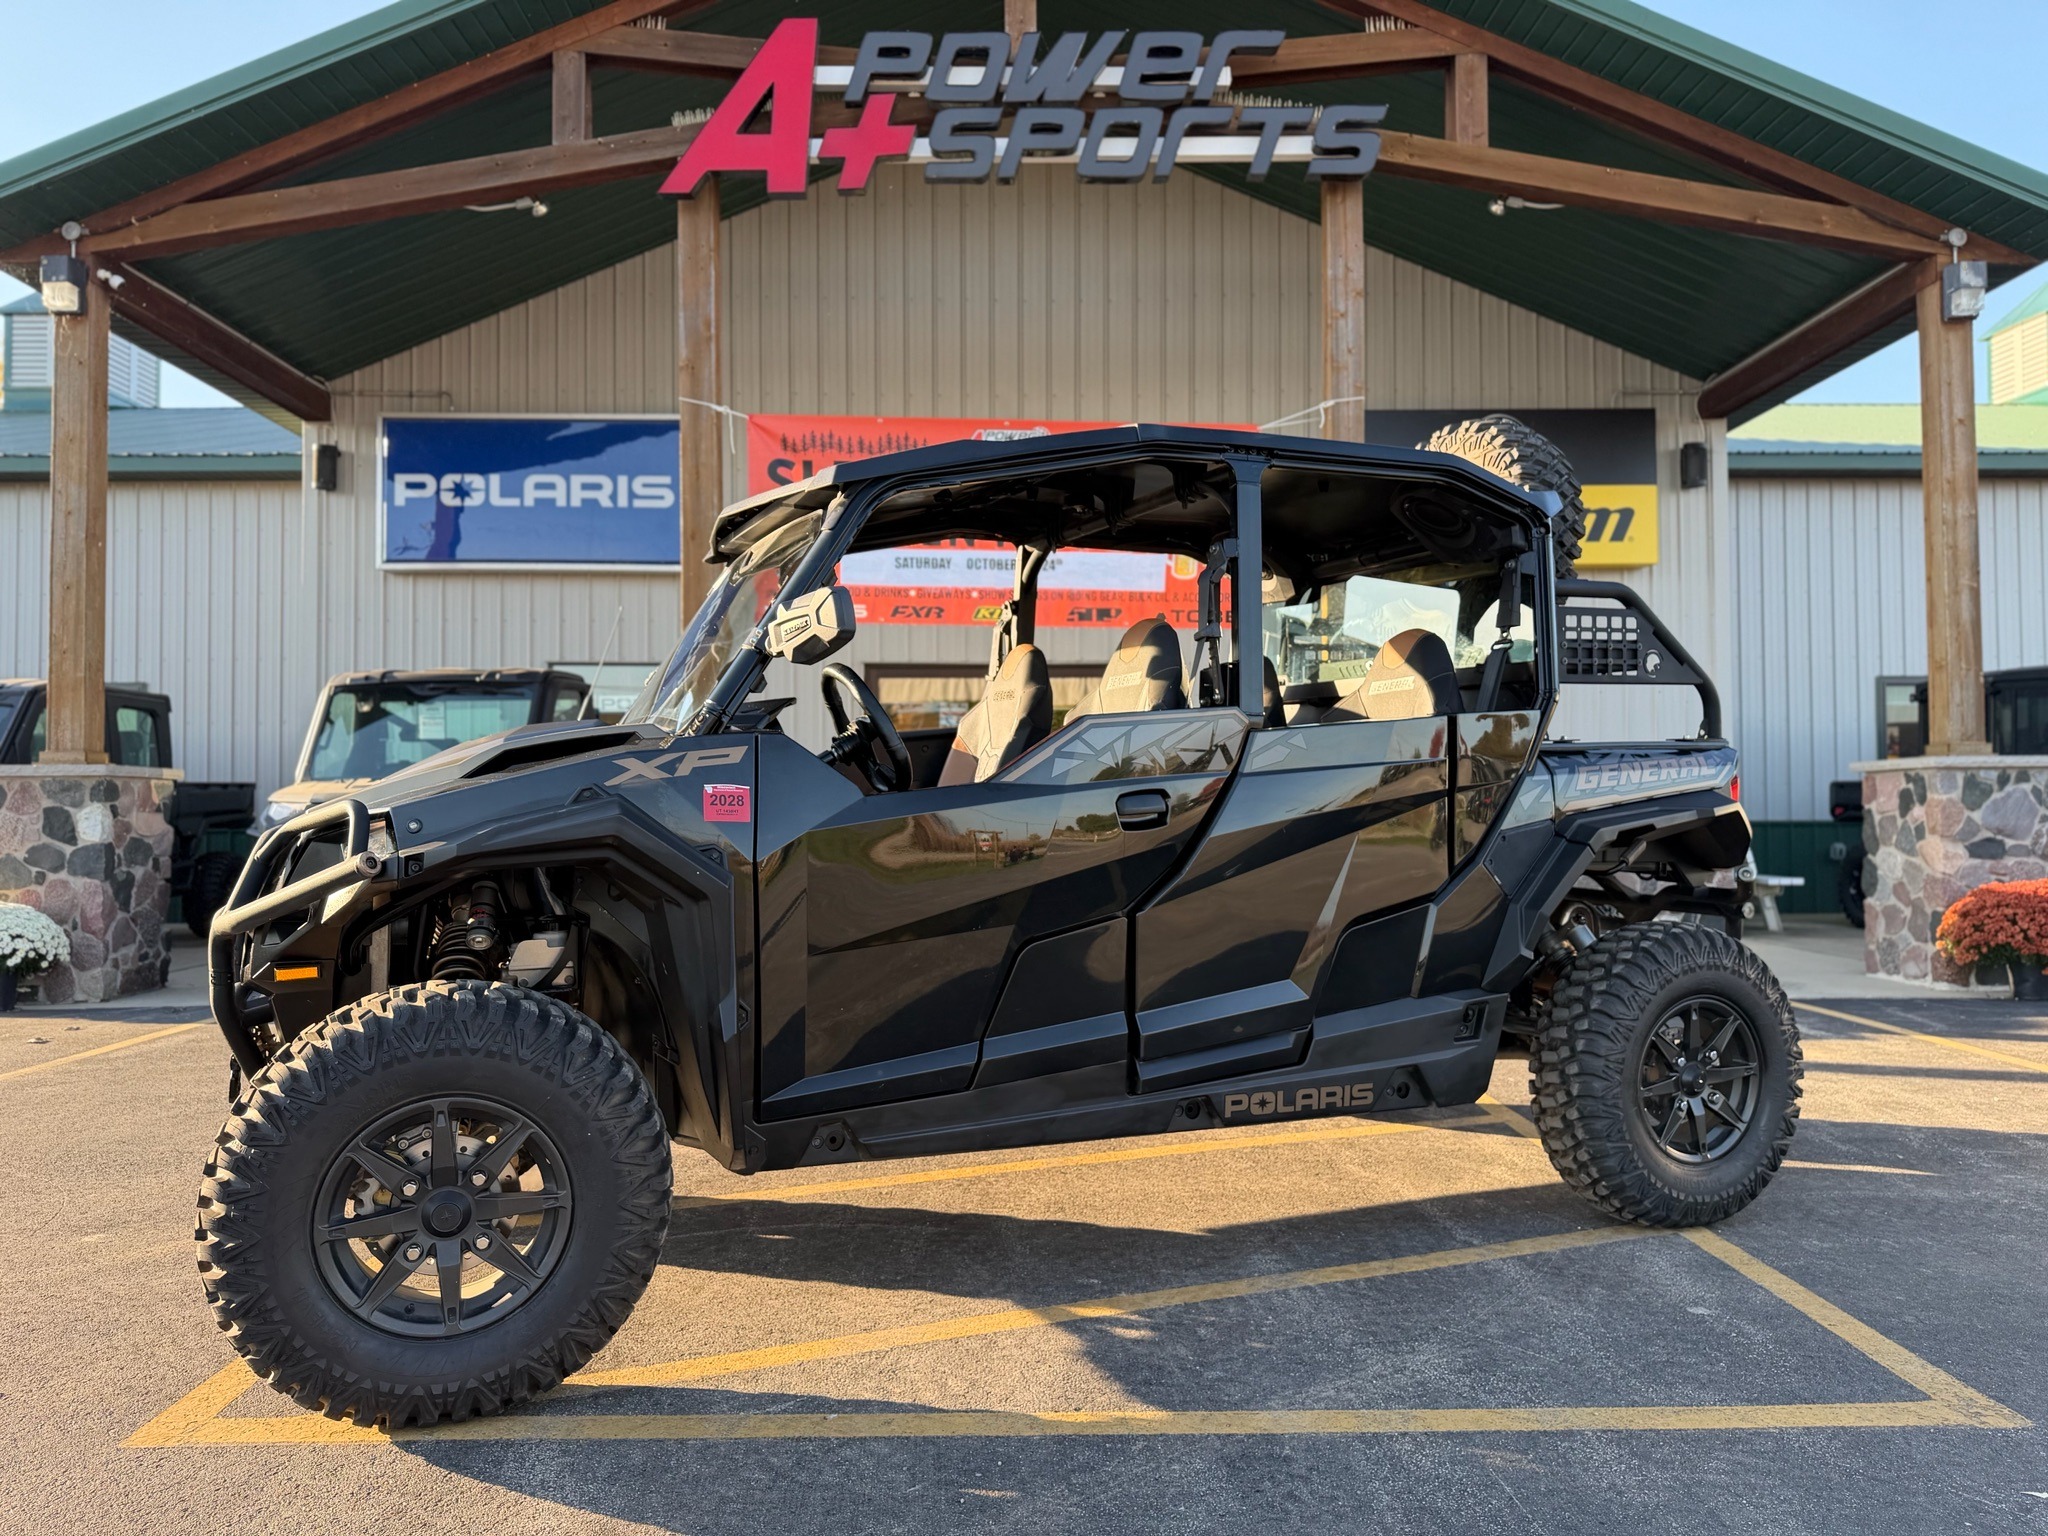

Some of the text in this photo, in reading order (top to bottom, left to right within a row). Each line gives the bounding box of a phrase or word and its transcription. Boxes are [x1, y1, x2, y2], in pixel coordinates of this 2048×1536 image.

[393, 472, 675, 508] POLARIS
[894, 557, 952, 569] SATURDAY
[966, 558, 1017, 571] OCTOBER
[874, 586, 909, 599] DRINKS
[916, 587, 972, 600] GIVEAWAYS
[979, 588, 1006, 600] SHOW
[890, 605, 945, 619] FXR
[604, 745, 749, 787] XP
[1576, 756, 1717, 791] GENERAL
[710, 794, 744, 807] 2028
[1224, 1082, 1375, 1119] POLARIS
